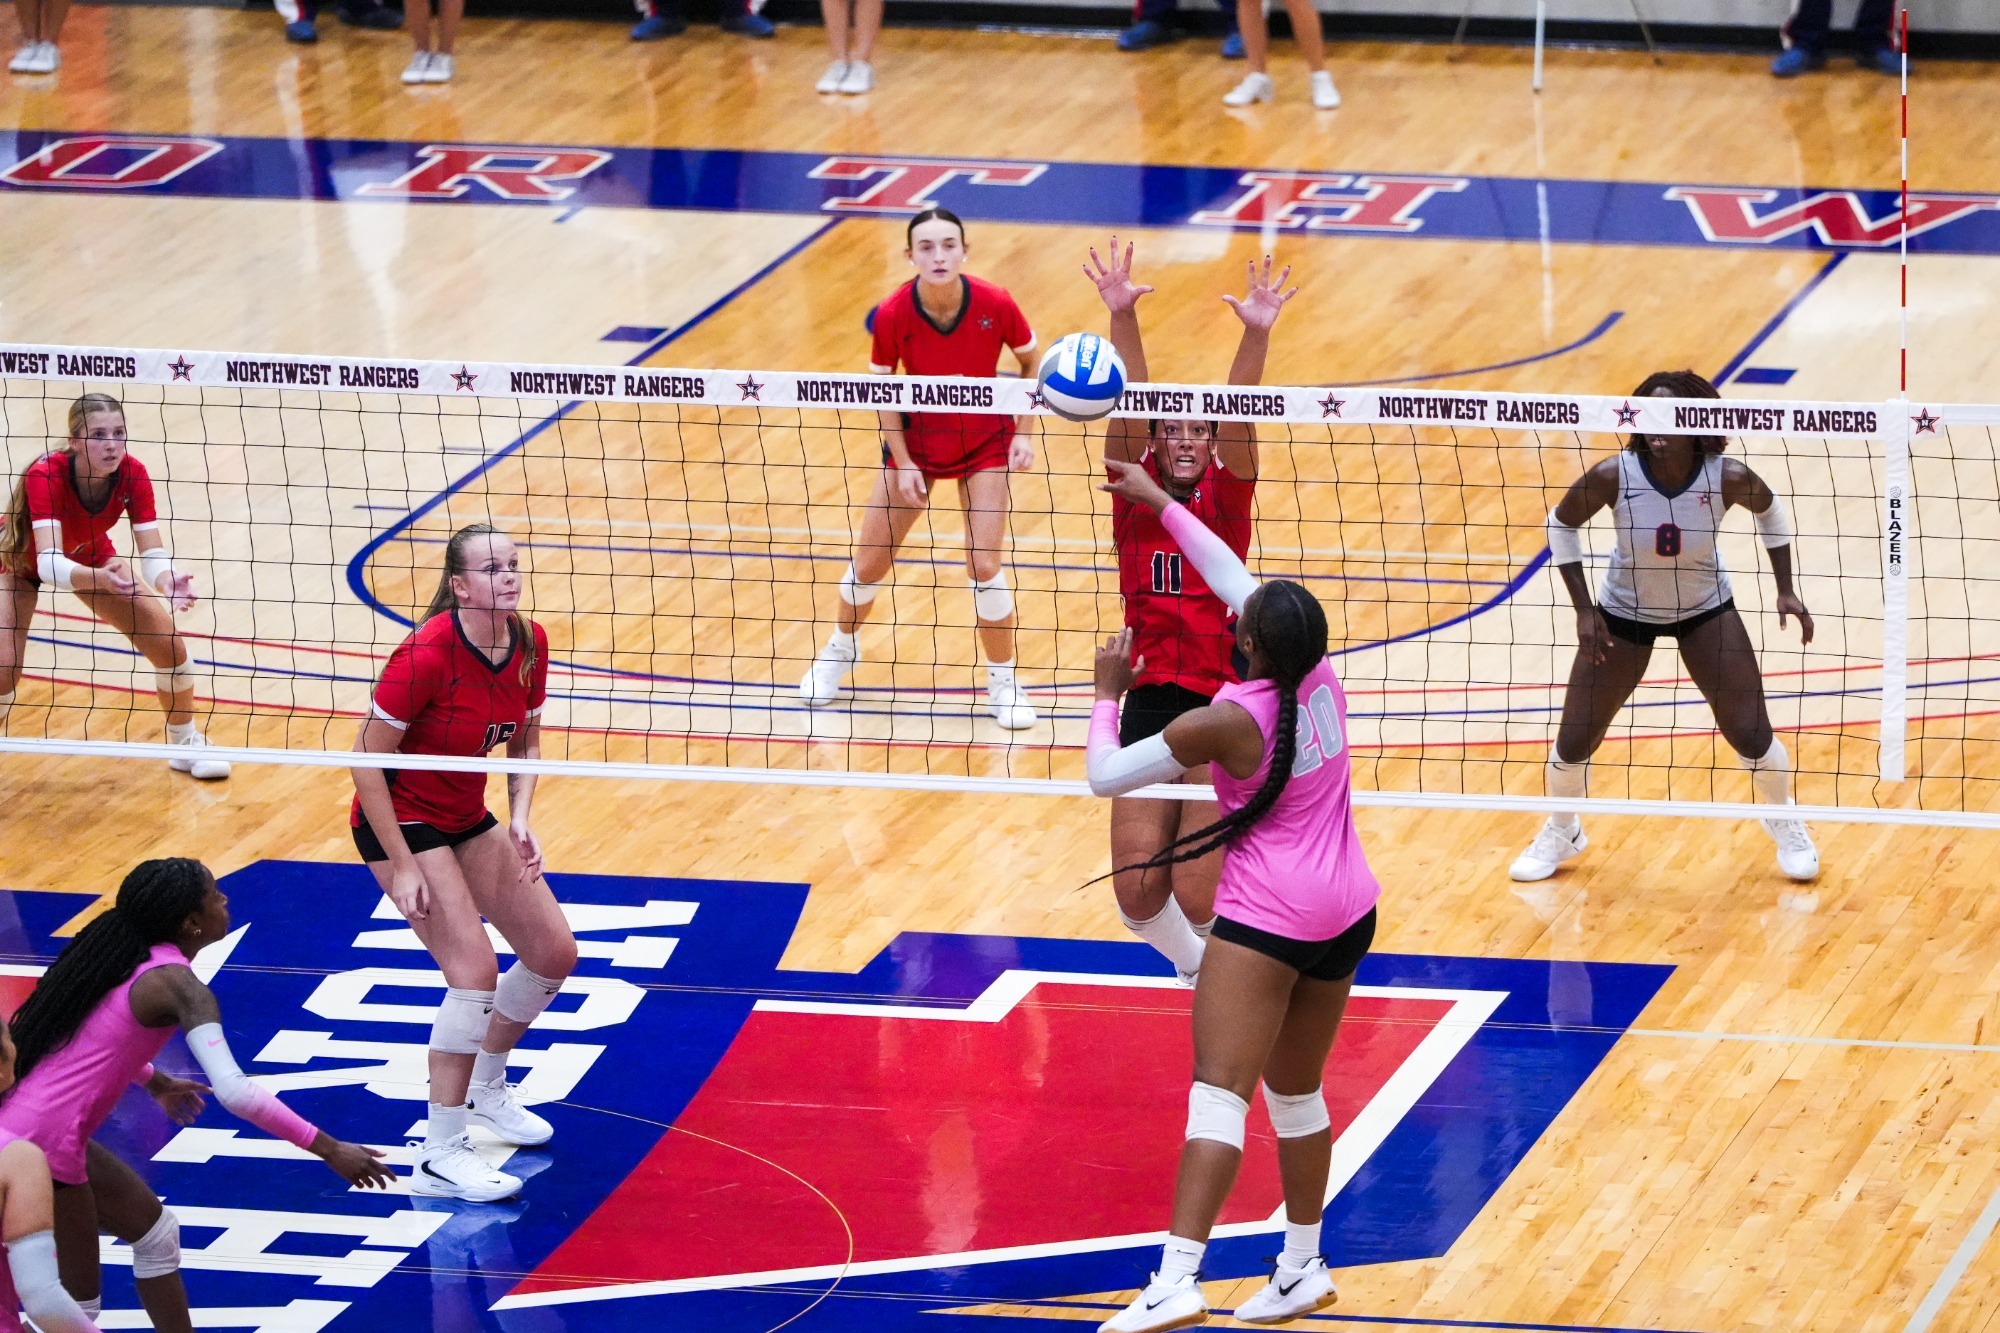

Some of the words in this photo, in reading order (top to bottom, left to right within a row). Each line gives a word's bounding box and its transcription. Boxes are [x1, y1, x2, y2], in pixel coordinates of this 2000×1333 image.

[0, 352, 50, 374] WEST
[57, 354, 136, 378] RANGERS
[226, 361, 331, 386] NORTHWEST
[339, 365, 419, 389] RANGERS
[510, 371, 616, 395] NORTHWEST
[624, 375, 705, 398] RANGERS
[797, 380, 903, 404] NORTHWEST
[911, 384, 993, 407] RANGERS
[1202, 393, 1285, 416] RANGERS
[1378, 396, 1488, 421] NORTHWEST
[1496, 400, 1580, 424] RANGERS
[1674, 406, 1785, 431] NORTHWEST
[1793, 409, 1877, 433] RANGERS
[1655, 522, 1682, 557] 8
[1887, 498, 1903, 564] BLAZER
[1151, 550, 1182, 595] 11
[1291, 683, 1343, 779] 20
